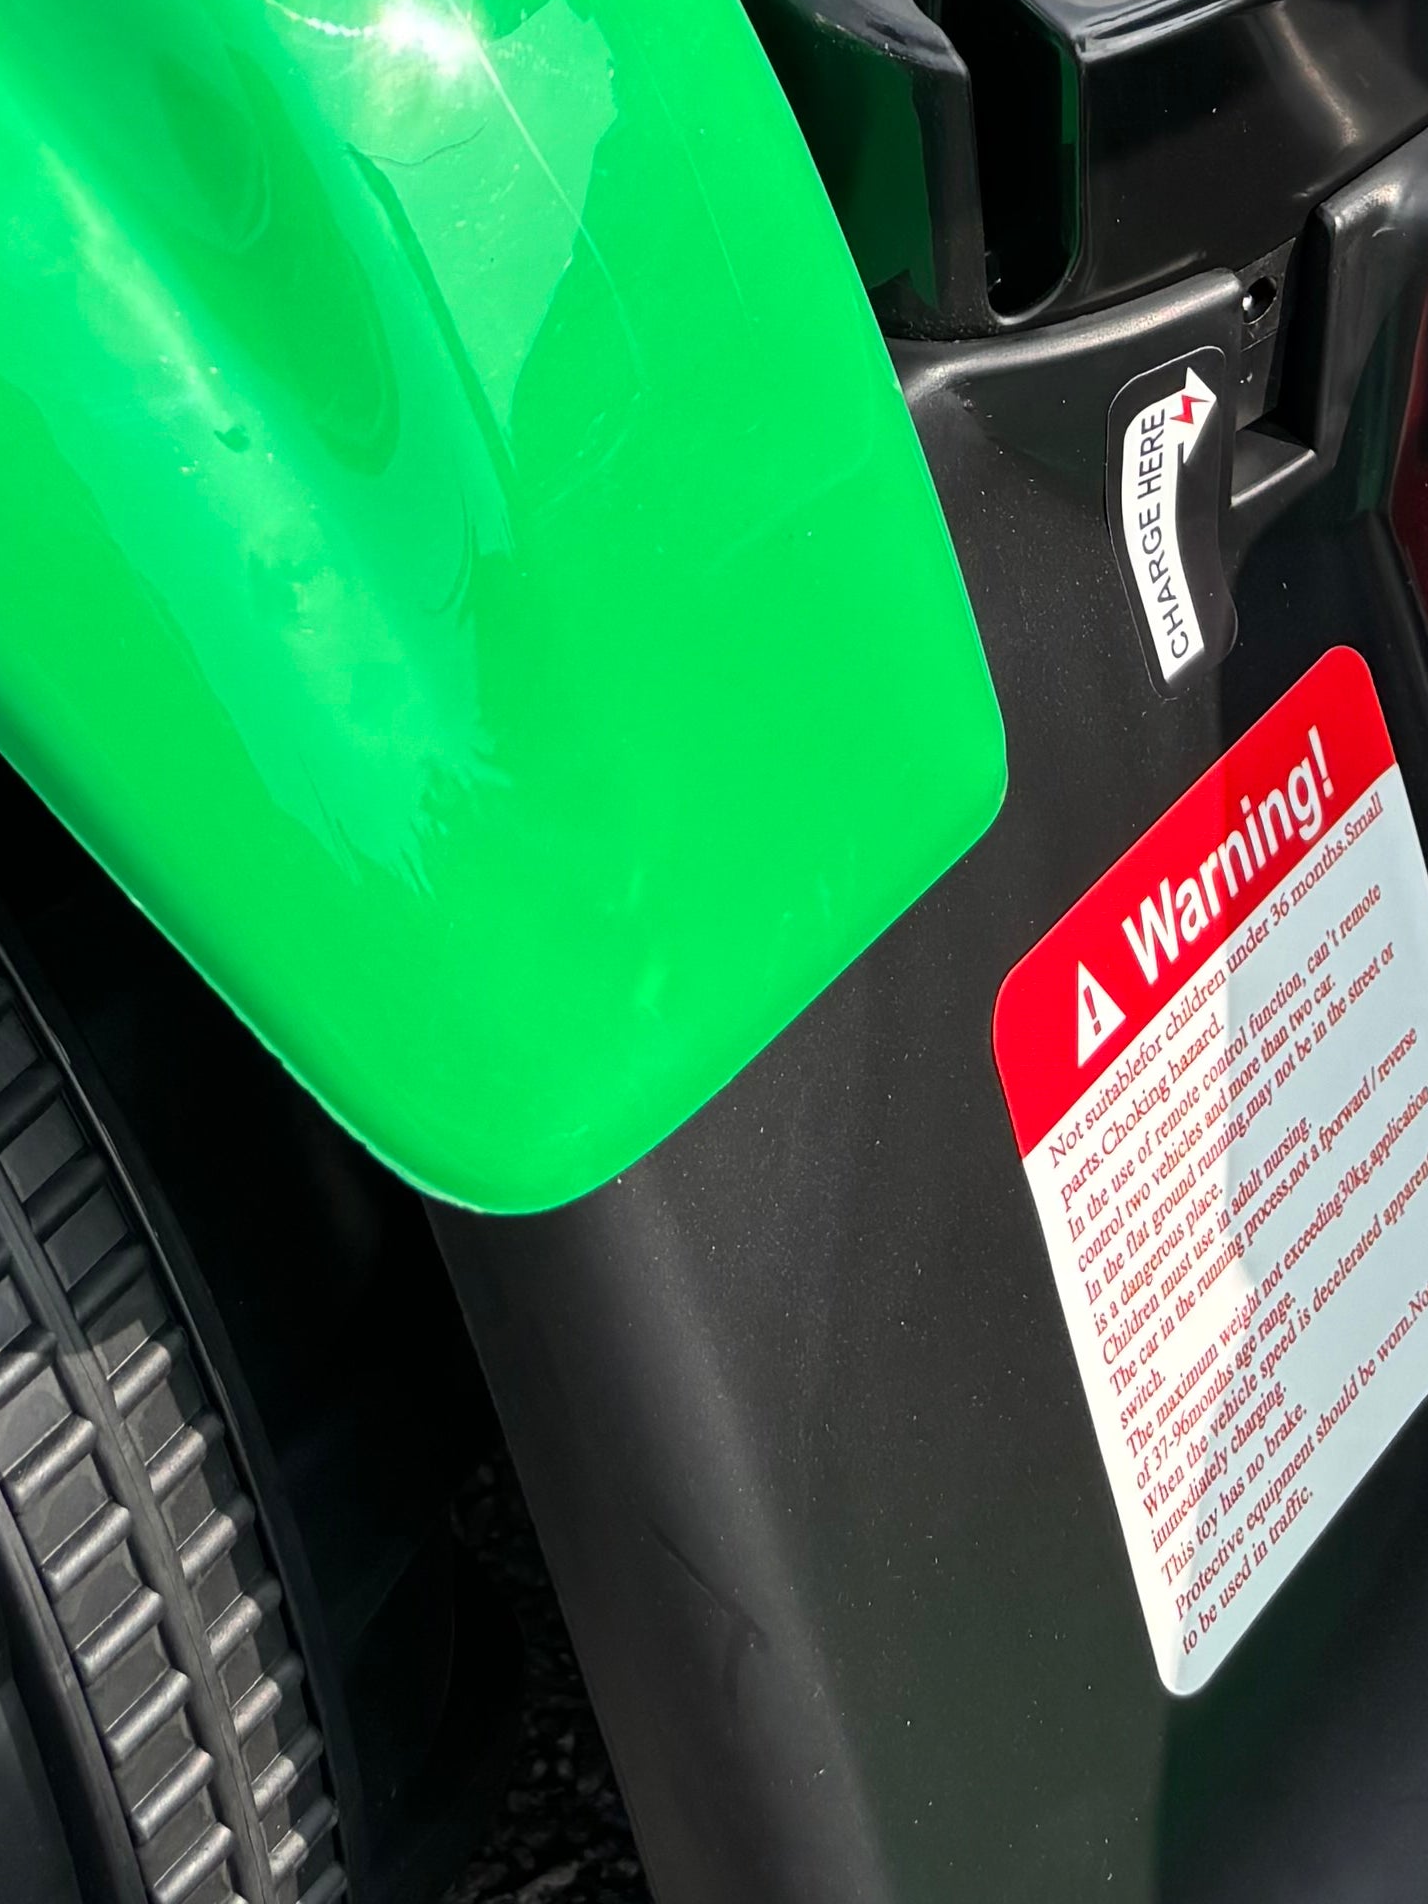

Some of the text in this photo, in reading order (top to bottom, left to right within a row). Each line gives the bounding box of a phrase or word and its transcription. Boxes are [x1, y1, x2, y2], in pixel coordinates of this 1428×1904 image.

[1137, 408, 1189, 660] CHARGE HERE
[1121, 726, 1333, 984] Warning!
[1047, 1120, 1084, 1169] Not
[1165, 968, 1226, 1041] children
[1225, 917, 1270, 974] under
[1269, 891, 1289, 926] 36
[1066, 1215, 1085, 1243] In
[1086, 1187, 1109, 1221] the
[1110, 1158, 1135, 1193] use
[1137, 1130, 1153, 1164] of
[1154, 1085, 1200, 1146] remote
[1202, 1025, 1248, 1091] control
[1338, 884, 1380, 939] remote
[1077, 1204, 1125, 1273] control
[1124, 1182, 1150, 1218] two
[1150, 1121, 1203, 1185] vehicles
[1204, 1087, 1228, 1129] and
[1227, 1056, 1260, 1102] more
[1260, 1024, 1289, 1063] than
[1288, 997, 1312, 1032] two
[1084, 1278, 1102, 1306] In
[1102, 1251, 1125, 1284] the
[1125, 1220, 1150, 1259] flat
[1151, 1162, 1196, 1236] ground
[1273, 1052, 1296, 1088] not
[1293, 1036, 1312, 1062] be
[1310, 1019, 1327, 1044] in
[1326, 996, 1346, 1026] the
[1347, 956, 1380, 1004] street
[1380, 941, 1394, 965] or
[1166, 1011, 1224, 1084] hazard.
[1093, 1312, 1108, 1337] is
[1120, 1222, 1184, 1306] dangerous
[1184, 1182, 1223, 1237] place.
[1102, 1116, 1312, 1365] Children must use in adult nursing.
[1108, 1359, 1137, 1396] The
[1138, 1331, 1159, 1365] car
[1158, 1315, 1175, 1341] in
[1174, 1289, 1196, 1322] the
[1196, 1231, 1245, 1297] running
[1376, 1027, 1417, 1082] reverse
[1119, 1368, 1166, 1430] switch.
[1125, 1420, 1154, 1458] The
[1155, 1342, 1219, 1428] maximum
[1218, 1286, 1262, 1347] weight
[1260, 1261, 1283, 1298] not
[1136, 1455, 1151, 1490] of
[1234, 1334, 1257, 1370] age
[1142, 1464, 1185, 1518] When
[1185, 1434, 1208, 1469] the
[1209, 1373, 1258, 1438] vehicle
[1259, 1318, 1297, 1380] speed
[1296, 1306, 1311, 1332] is
[1312, 1212, 1382, 1312] decelerated
[1150, 1373, 1286, 1553] immediately charging.
[1160, 1403, 1307, 1586] This toy has no brake.
[1174, 1526, 1244, 1621] Protective
[1246, 1433, 1315, 1531] equipment
[1315, 1373, 1359, 1444] should
[1357, 1358, 1376, 1386] be
[1182, 1485, 1313, 1655] to be used in traffic.
